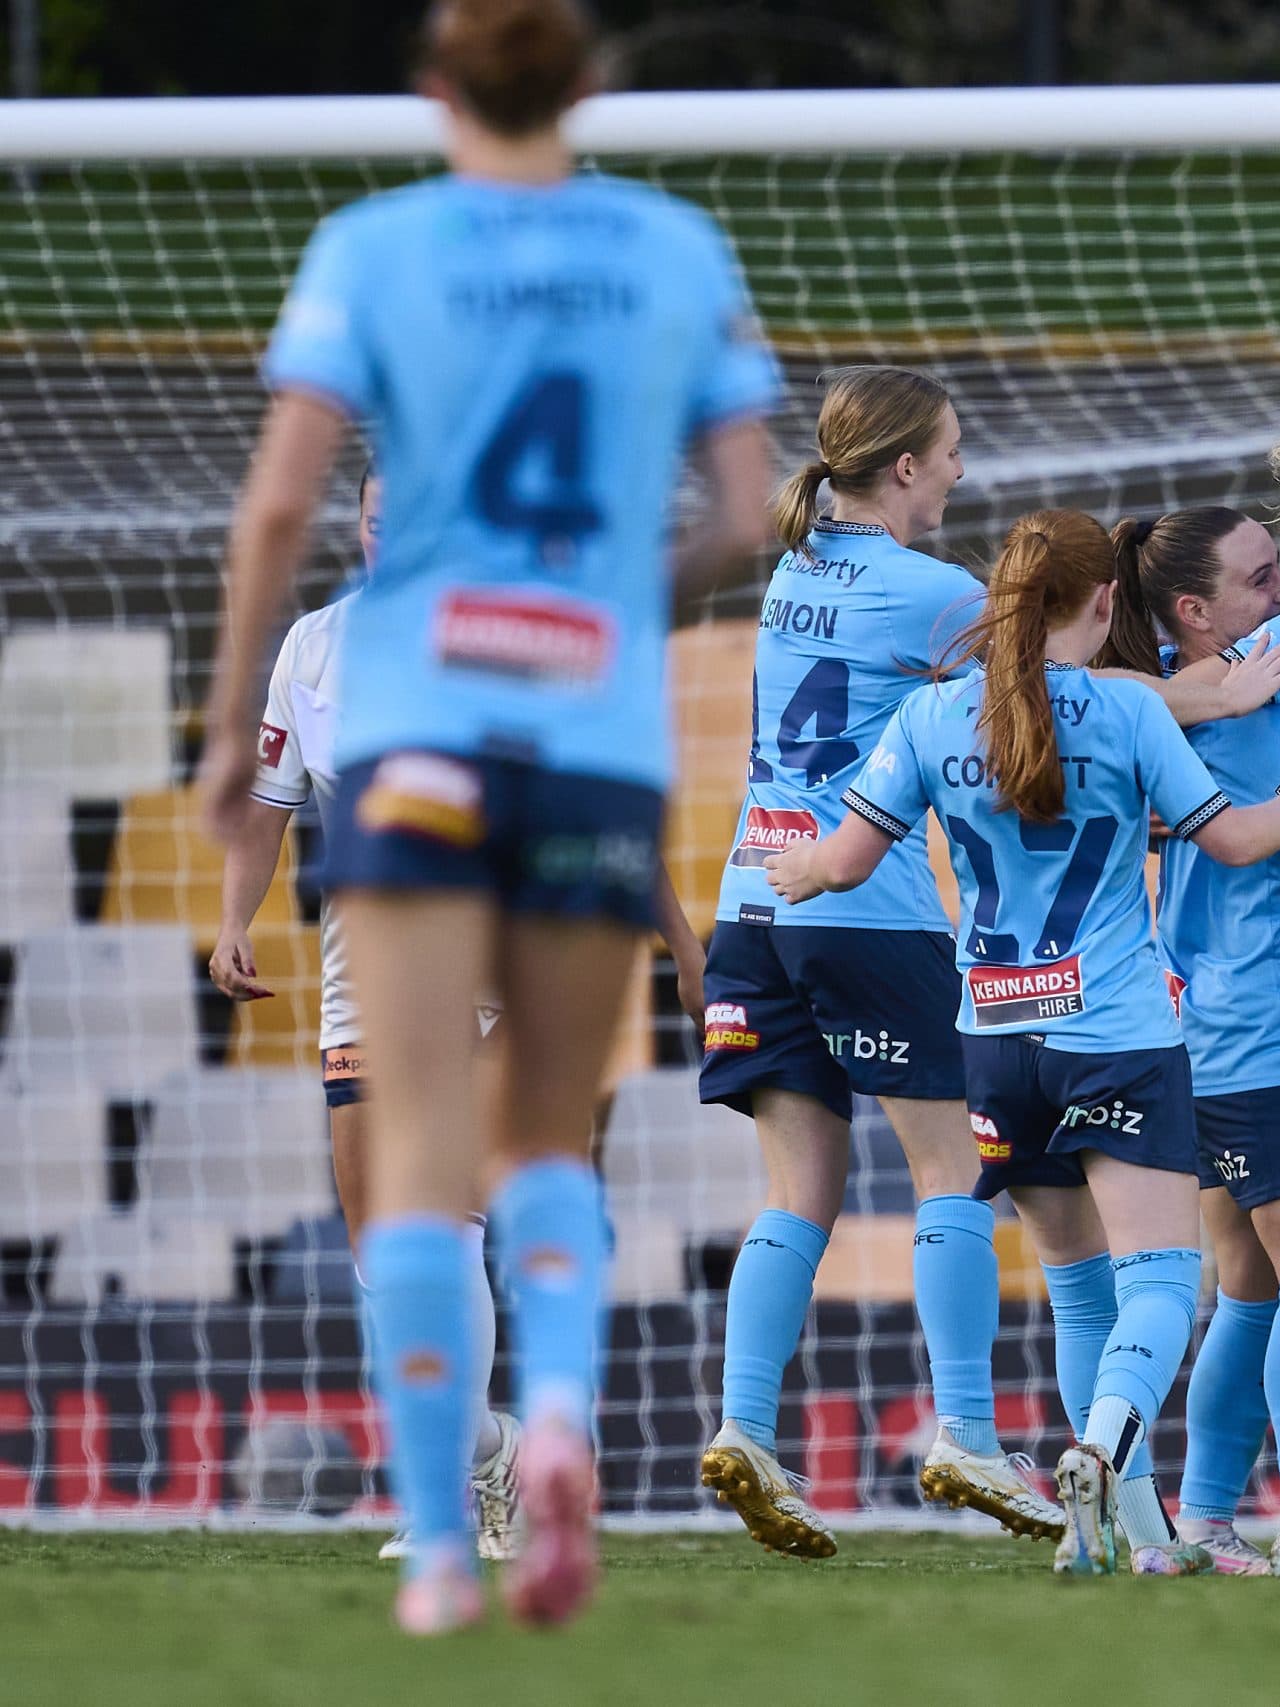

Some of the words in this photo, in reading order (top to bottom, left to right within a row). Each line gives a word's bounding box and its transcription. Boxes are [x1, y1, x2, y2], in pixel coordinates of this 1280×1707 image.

[468, 367, 607, 566] 4
[947, 814, 1118, 963] 17
[973, 971, 1076, 1000] KENNARDS
[1038, 997, 1078, 1017] HIRE
